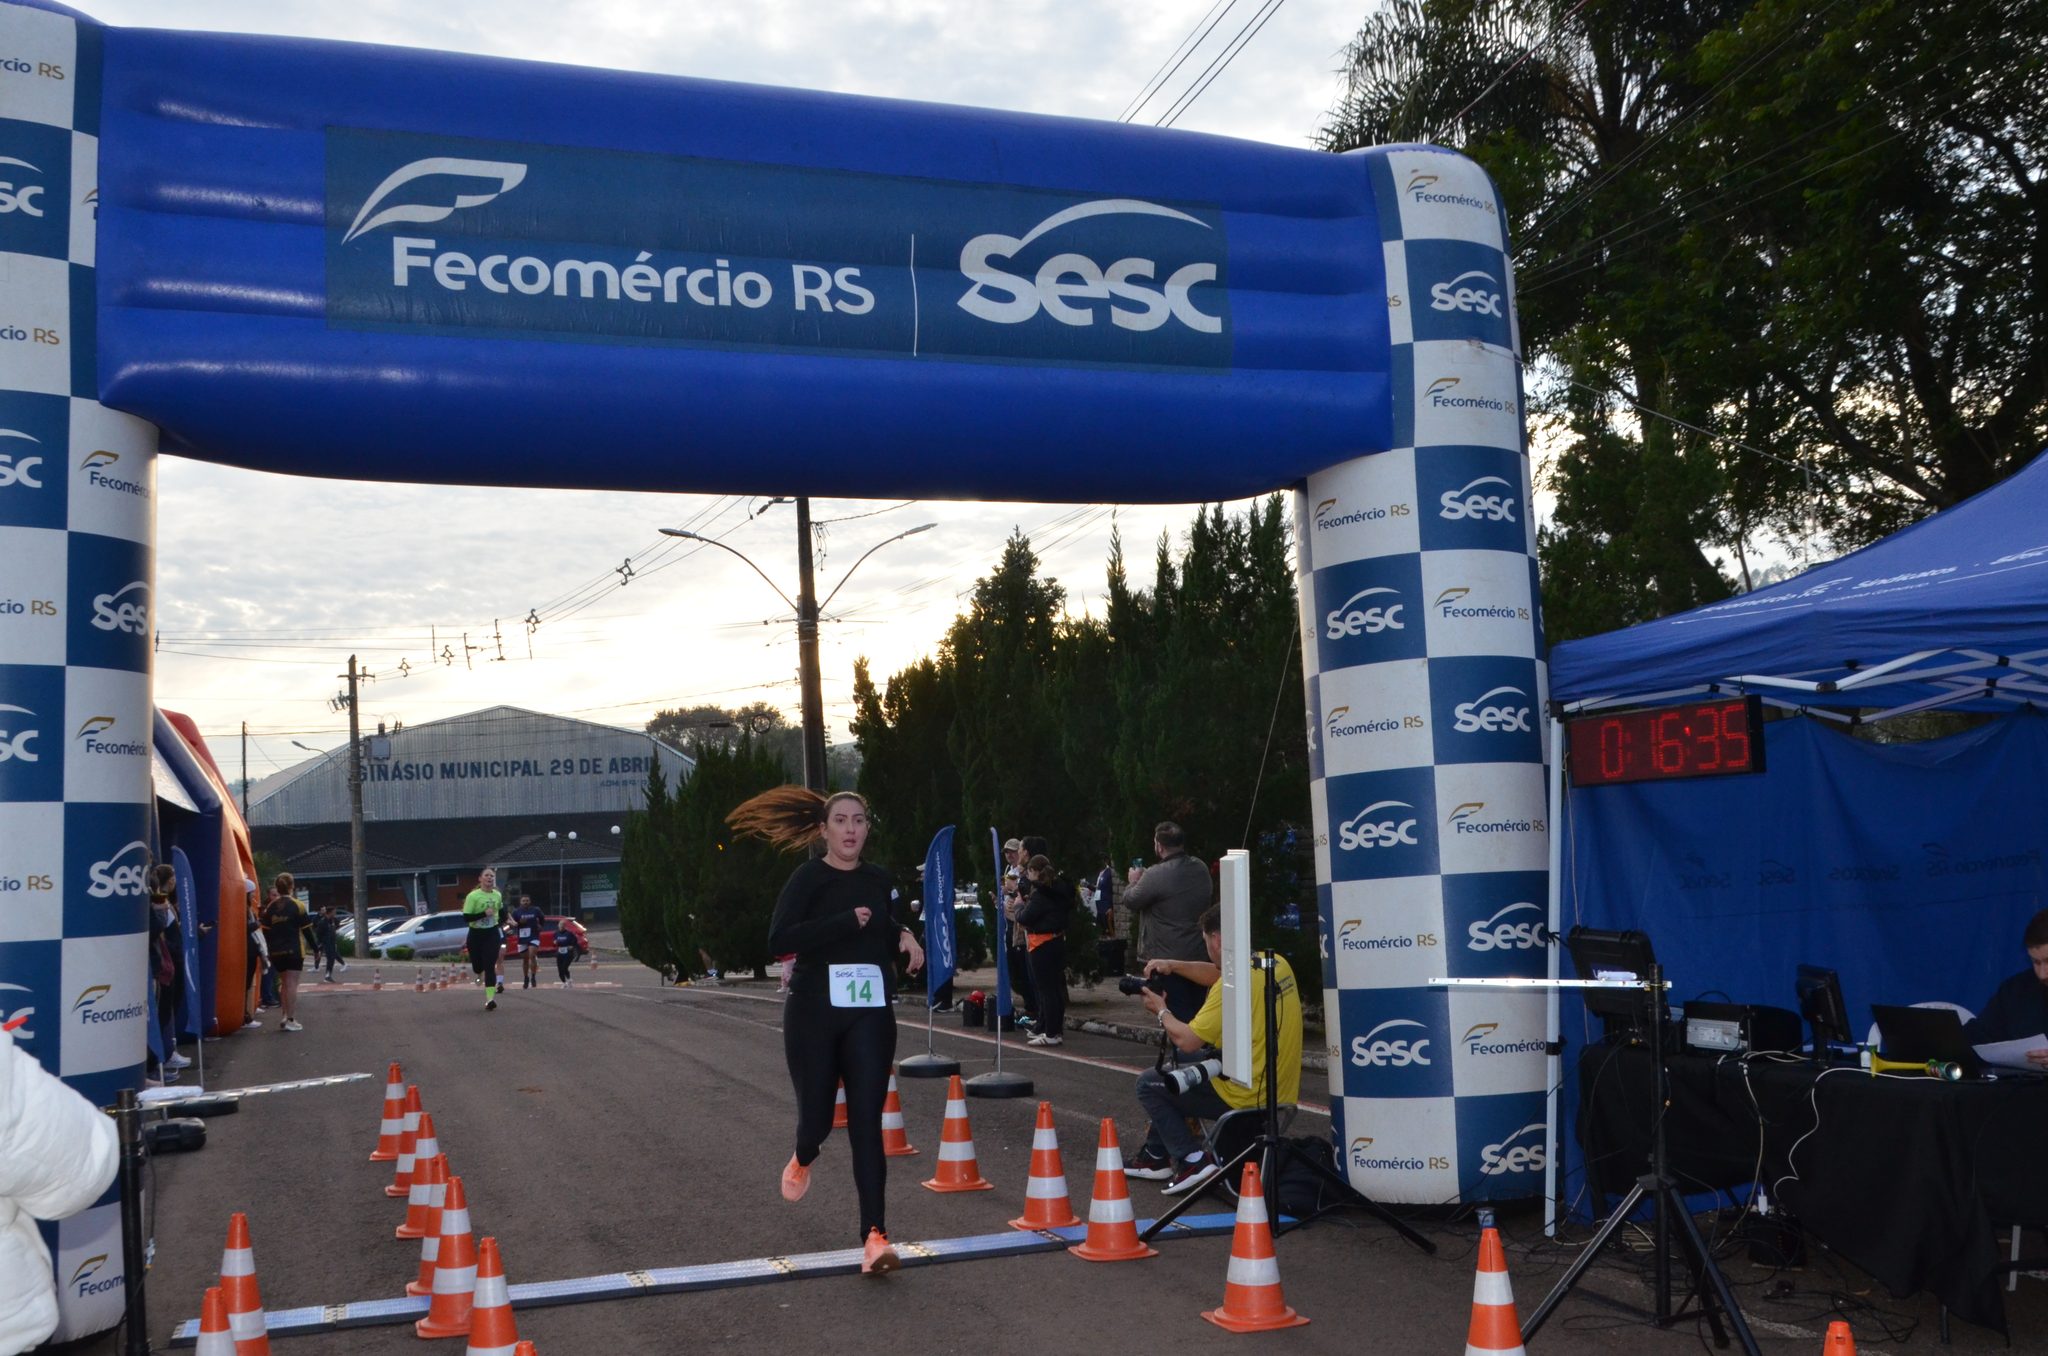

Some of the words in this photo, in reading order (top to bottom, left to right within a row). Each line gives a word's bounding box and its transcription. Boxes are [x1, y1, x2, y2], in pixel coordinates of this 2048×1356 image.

[38, 62, 65, 80] RS
[1415, 192, 1483, 209] Fecomércio
[393, 236, 773, 308] Fecomércio
[792, 264, 876, 315] RS
[957, 233, 1223, 334] Sesc
[1430, 282, 1502, 318] Sesc
[33, 328, 60, 345] RS
[1433, 396, 1503, 411] Fecomércio
[1504, 401, 1516, 415] RS
[1439, 490, 1516, 522] Sesc
[1318, 508, 1386, 531] Fecomércio
[1390, 504, 1410, 517] RS
[31, 600, 57, 616] RS
[91, 593, 149, 636] Ses
[1443, 606, 1516, 619] Fecomércio
[1518, 609, 1529, 621] RS
[1326, 604, 1405, 640] Sesc
[1330, 718, 1399, 738] Fecomércio
[1403, 716, 1424, 729] RS
[1453, 702, 1531, 733] Sesc
[440, 760, 544, 780] MUNICIPAL
[550, 759, 575, 776] 29
[579, 758, 603, 775] DE
[608, 757, 650, 774] ABRI
[1339, 818, 1418, 851] Sesc
[1457, 819, 1531, 834] Fecomércio
[1533, 819, 1545, 832] RS
[27, 875, 53, 890] RS
[1343, 935, 1412, 950] Fecomércio
[1416, 934, 1437, 947] RS
[1467, 921, 1546, 951] Sesc
[846, 980, 872, 1003] 14
[1351, 1036, 1431, 1067] Sesc
[1470, 1039, 1545, 1055] Fecomércio
[1354, 1155, 1424, 1170] Fecomércio
[1428, 1157, 1449, 1170] RS
[1480, 1144, 1559, 1175] Ses
[79, 1275, 125, 1297] Fecom
